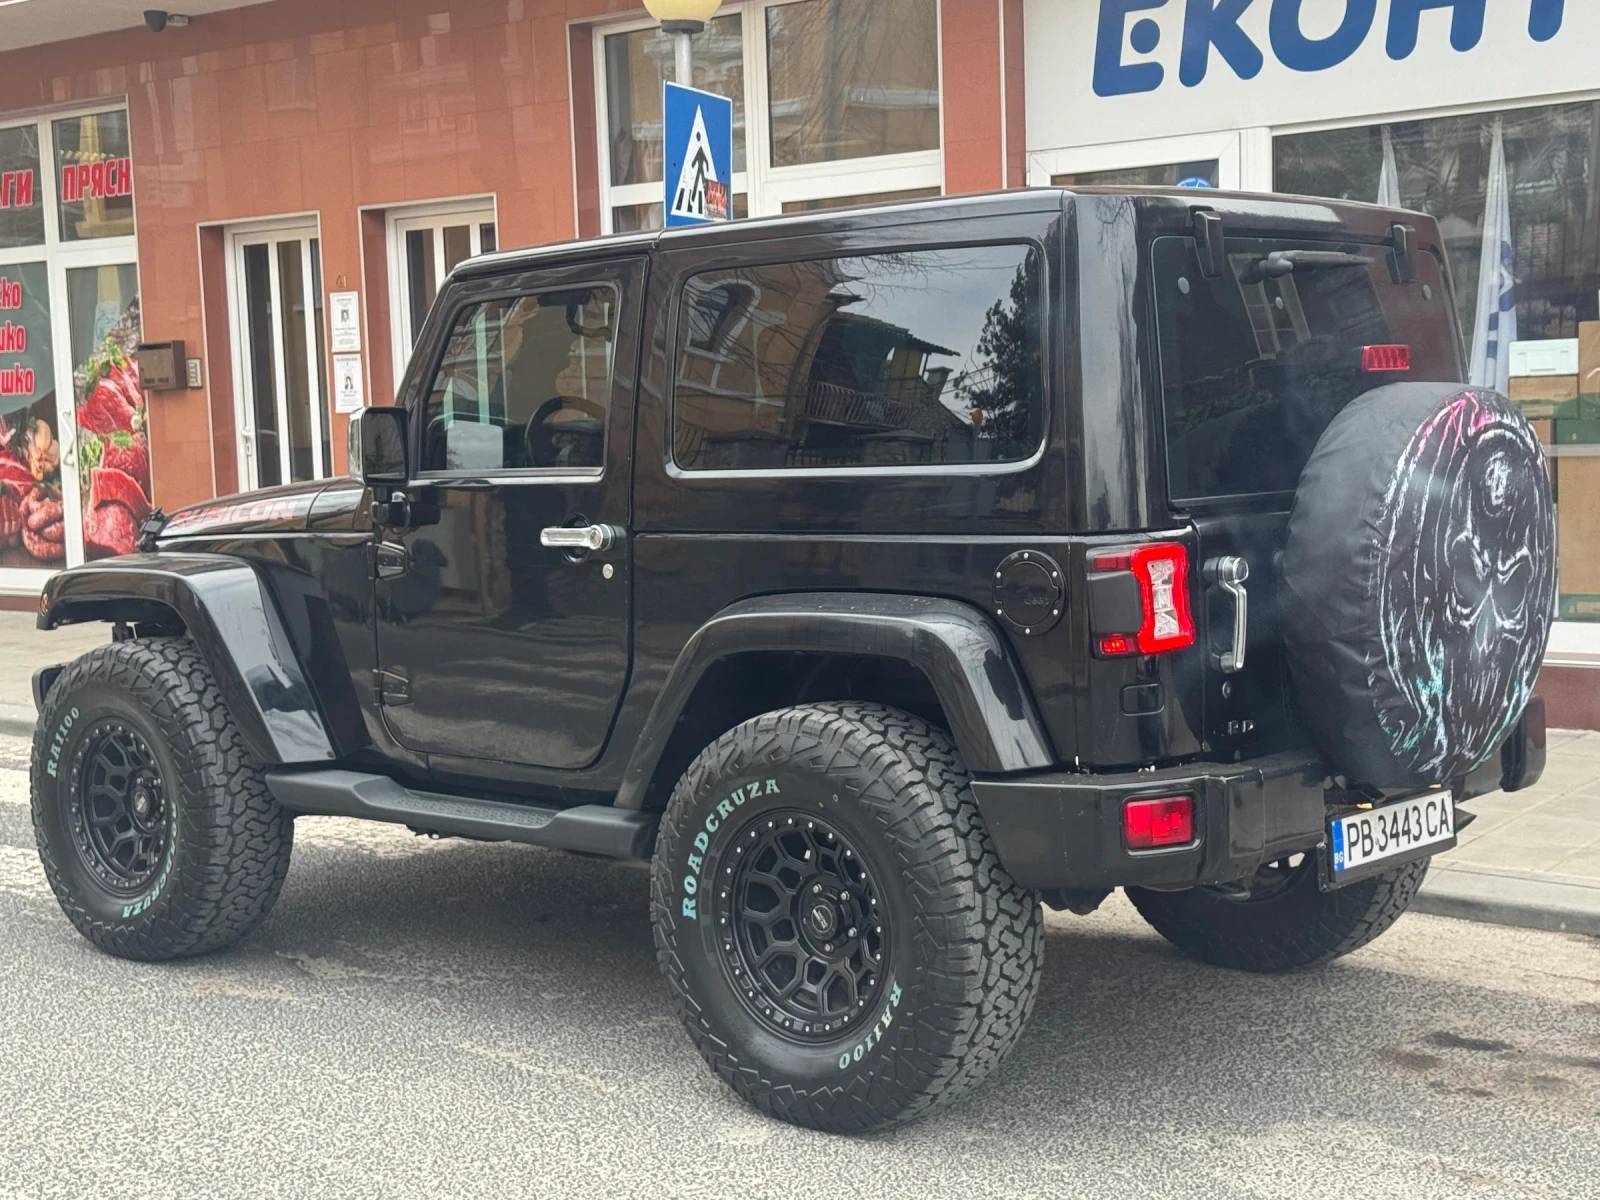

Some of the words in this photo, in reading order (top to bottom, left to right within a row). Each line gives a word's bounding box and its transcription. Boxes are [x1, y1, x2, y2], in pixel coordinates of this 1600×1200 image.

[0, 169, 33, 208] ГИ
[0, 276, 22, 309] ко
[46, 706, 80, 778] RA1100
[682, 778, 781, 920] ROADCRUZA
[1333, 851, 1345, 864] BG
[838, 980, 902, 1070] RA1100
